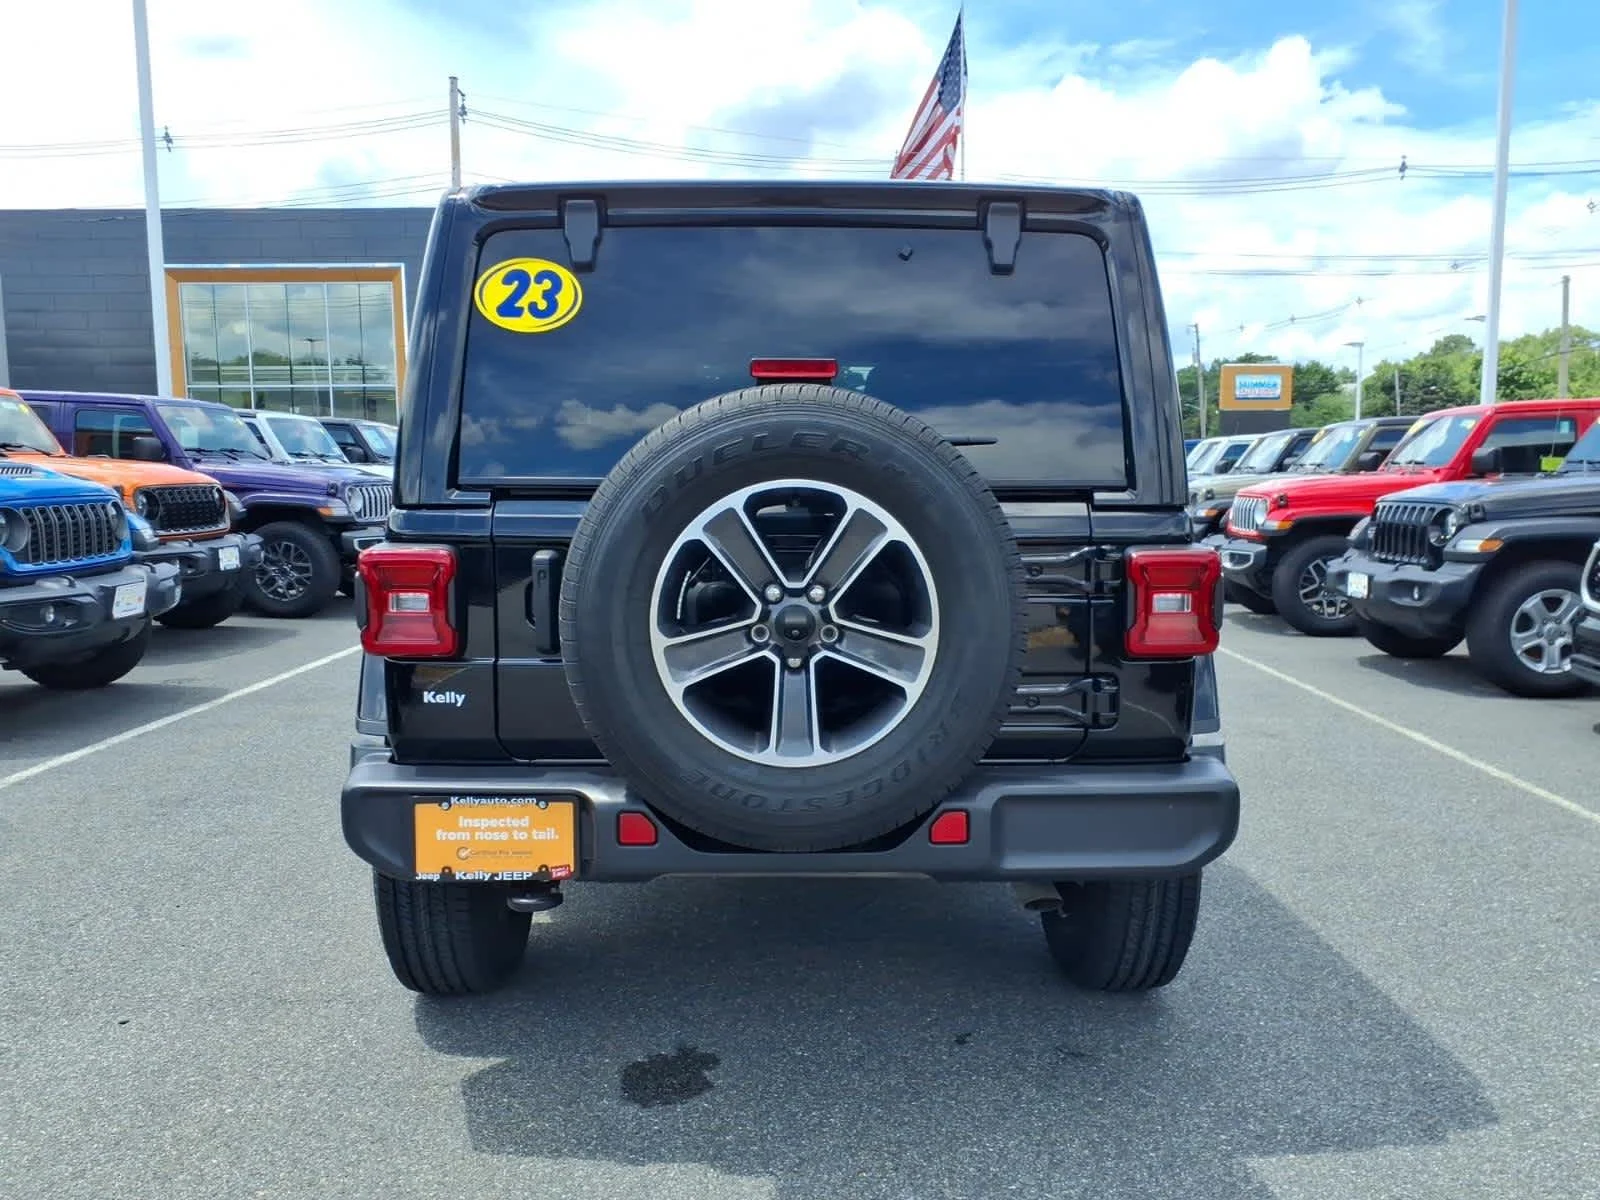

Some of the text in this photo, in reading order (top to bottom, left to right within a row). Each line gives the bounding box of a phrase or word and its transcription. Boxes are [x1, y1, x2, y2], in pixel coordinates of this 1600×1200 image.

[496, 269, 563, 319] 23
[423, 691, 466, 707] Kelly
[450, 796, 537, 806] Kellyauto.com
[458, 816, 530, 829] Inspected
[436, 829, 471, 840] from
[475, 830, 508, 840] nose
[513, 829, 528, 840] to
[415, 872, 440, 882] Jeep
[455, 871, 533, 881] Kelly JEEP
